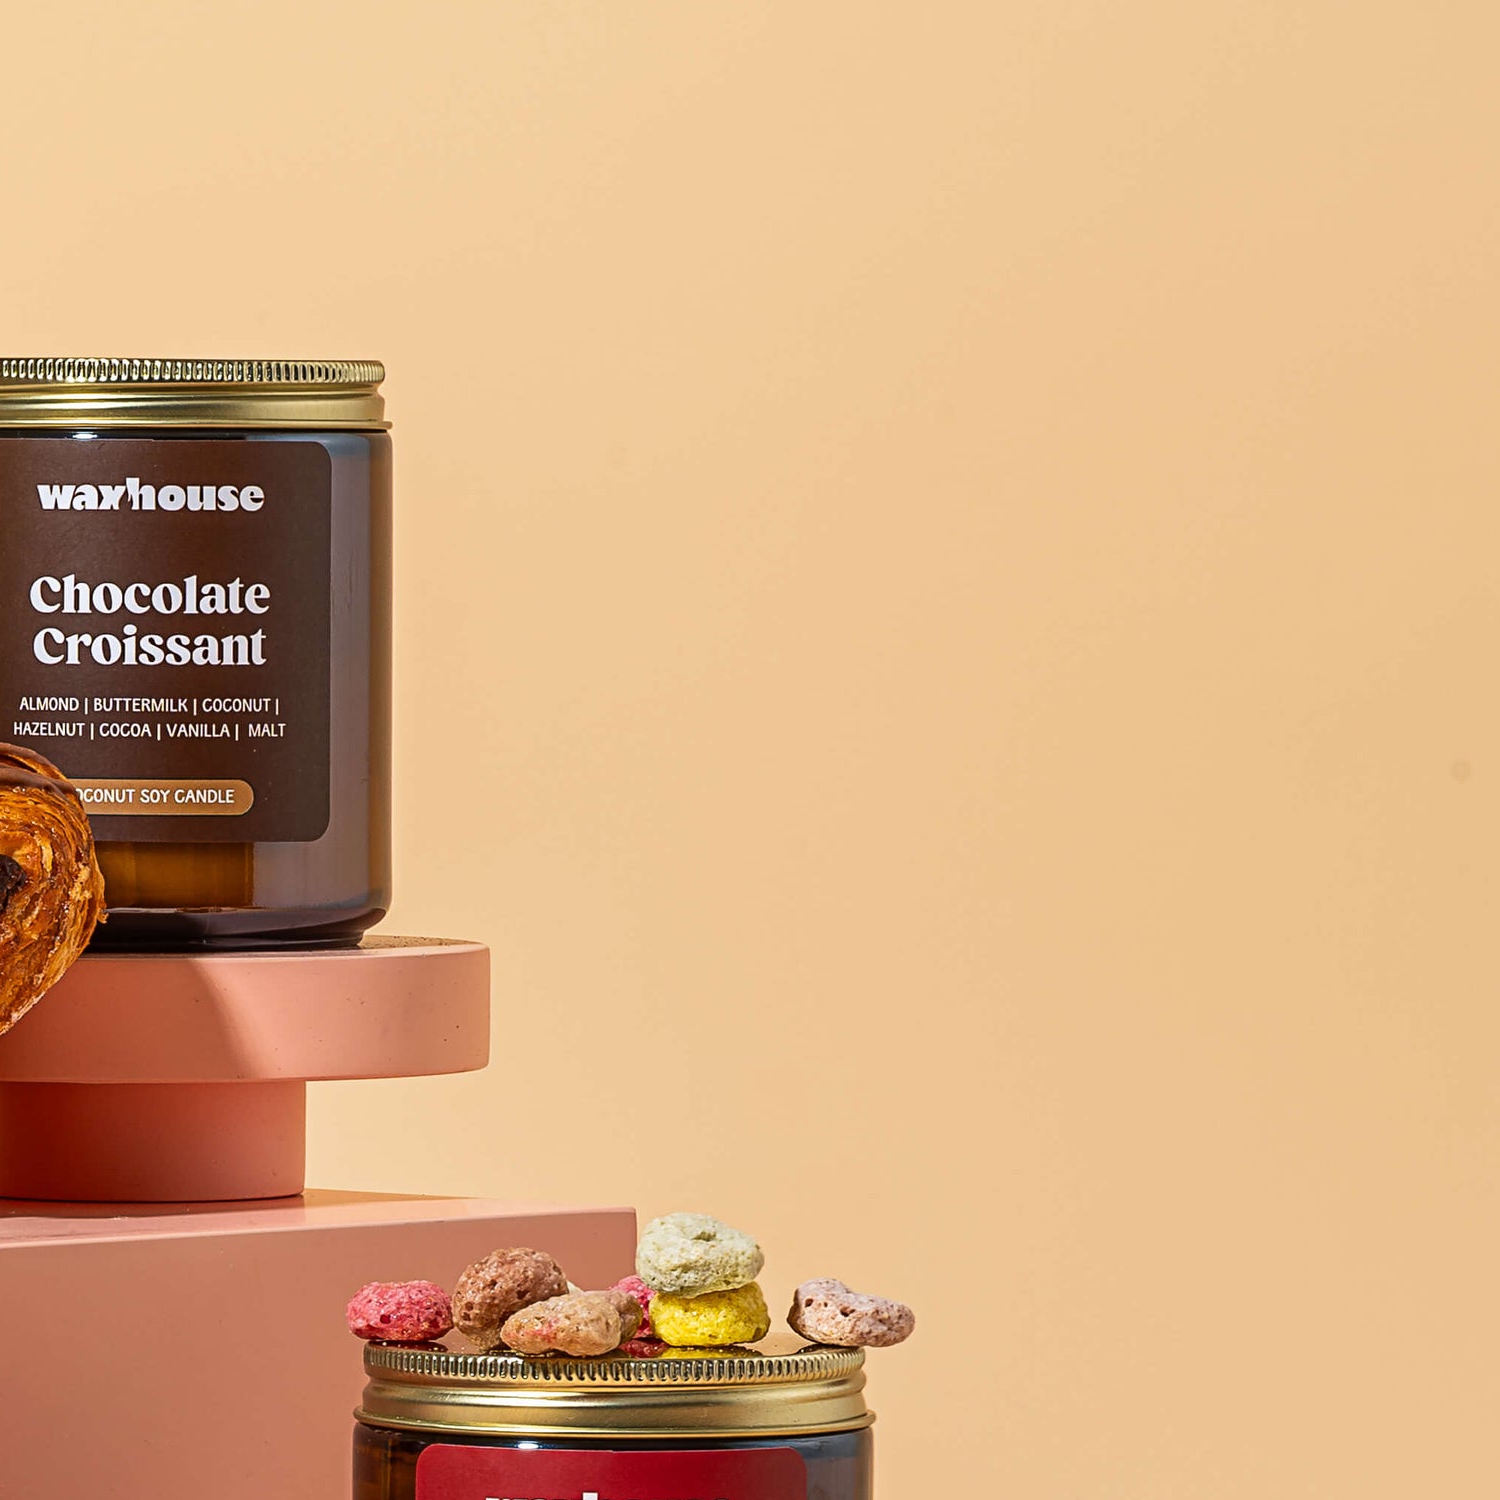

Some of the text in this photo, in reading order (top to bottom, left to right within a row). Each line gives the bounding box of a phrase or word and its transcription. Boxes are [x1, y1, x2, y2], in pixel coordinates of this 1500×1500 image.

[37, 478, 264, 511] waxhouse
[30, 574, 270, 614] Chocolate
[34, 625, 266, 665] Croissant
[19, 696, 79, 712] ALMOND
[93, 697, 188, 713] BUTTERMILK
[201, 697, 271, 713] COCONUT
[13, 721, 85, 737] HAZELNUT
[99, 722, 151, 738] COCOA
[165, 723, 230, 738] VANILLA
[248, 723, 286, 738] MALT
[76, 788, 234, 804] CONUT SOY CANDLE
